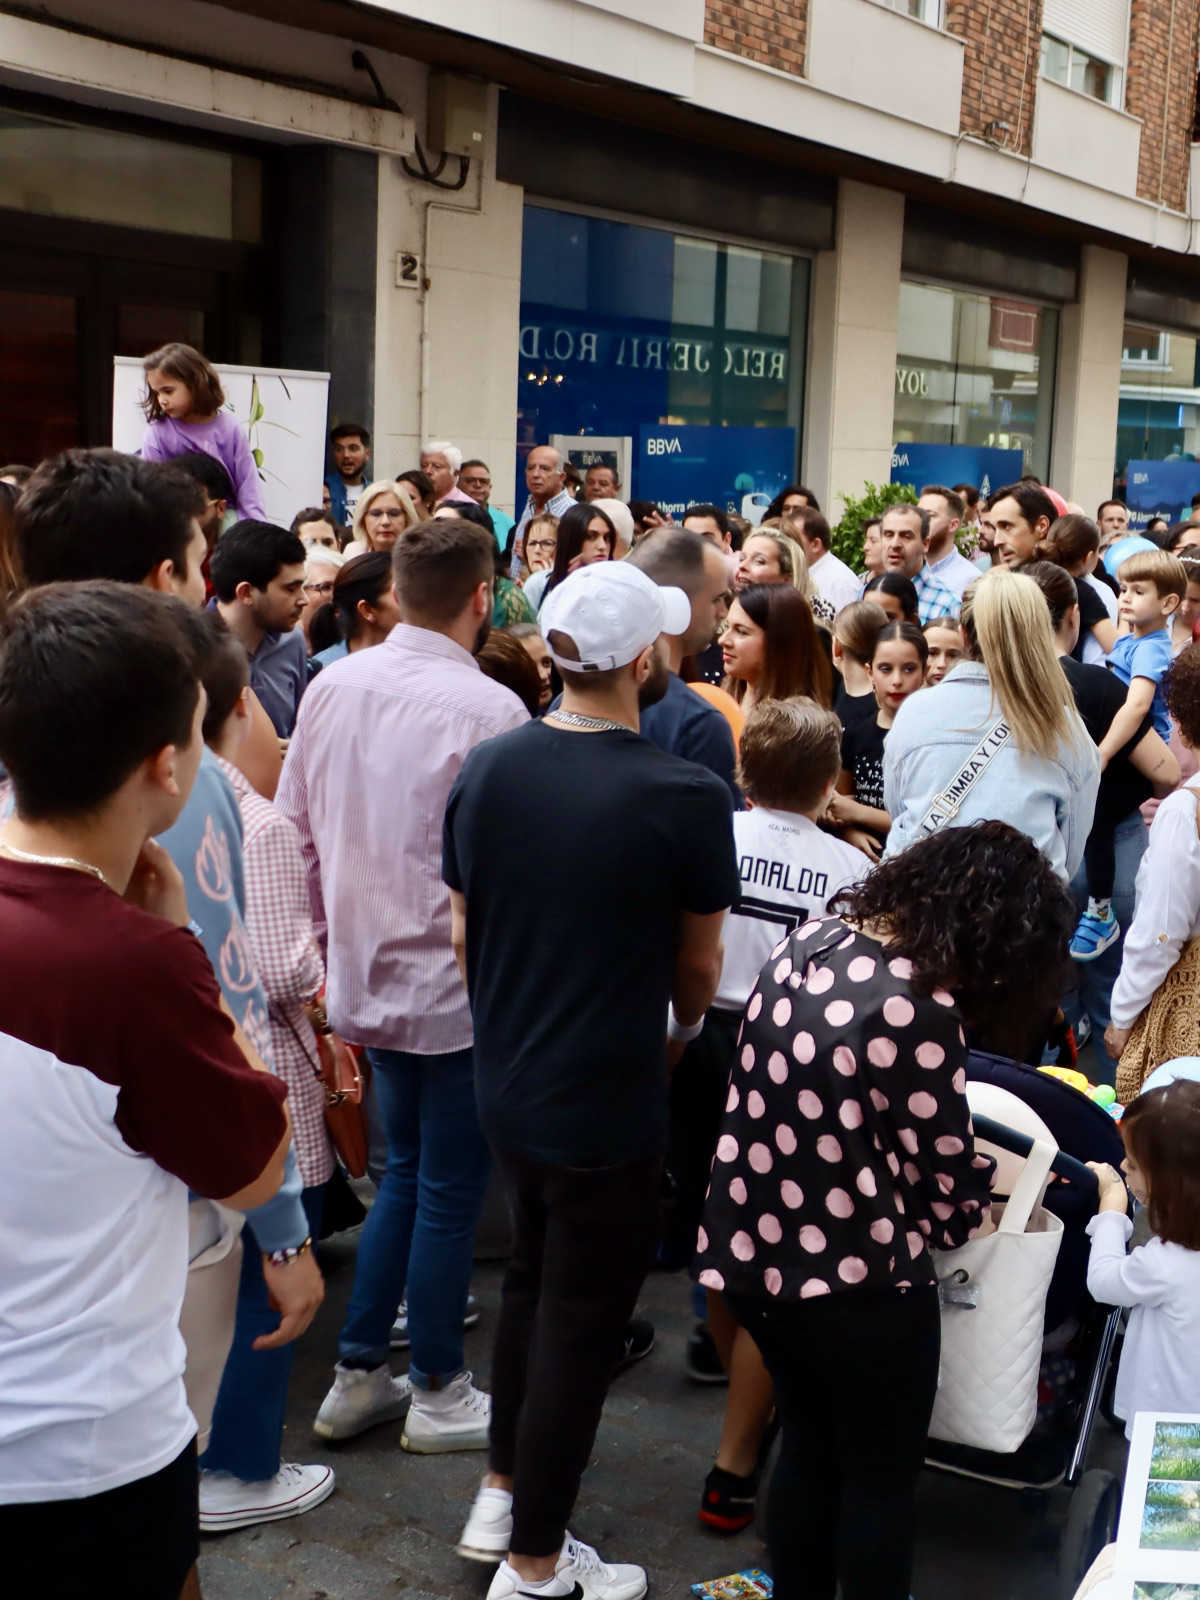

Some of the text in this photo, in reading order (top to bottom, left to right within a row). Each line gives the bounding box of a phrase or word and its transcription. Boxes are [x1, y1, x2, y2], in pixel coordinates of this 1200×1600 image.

[401, 254, 418, 281] 2
[647, 438, 682, 456] BBVA
[582, 454, 603, 465] BBVA
[891, 453, 910, 468] BVA
[657, 501, 685, 513] Ahorra
[944, 760, 983, 806] BIMBA
[977, 746, 990, 758] Y
[740, 855, 829, 898] ONALDO
